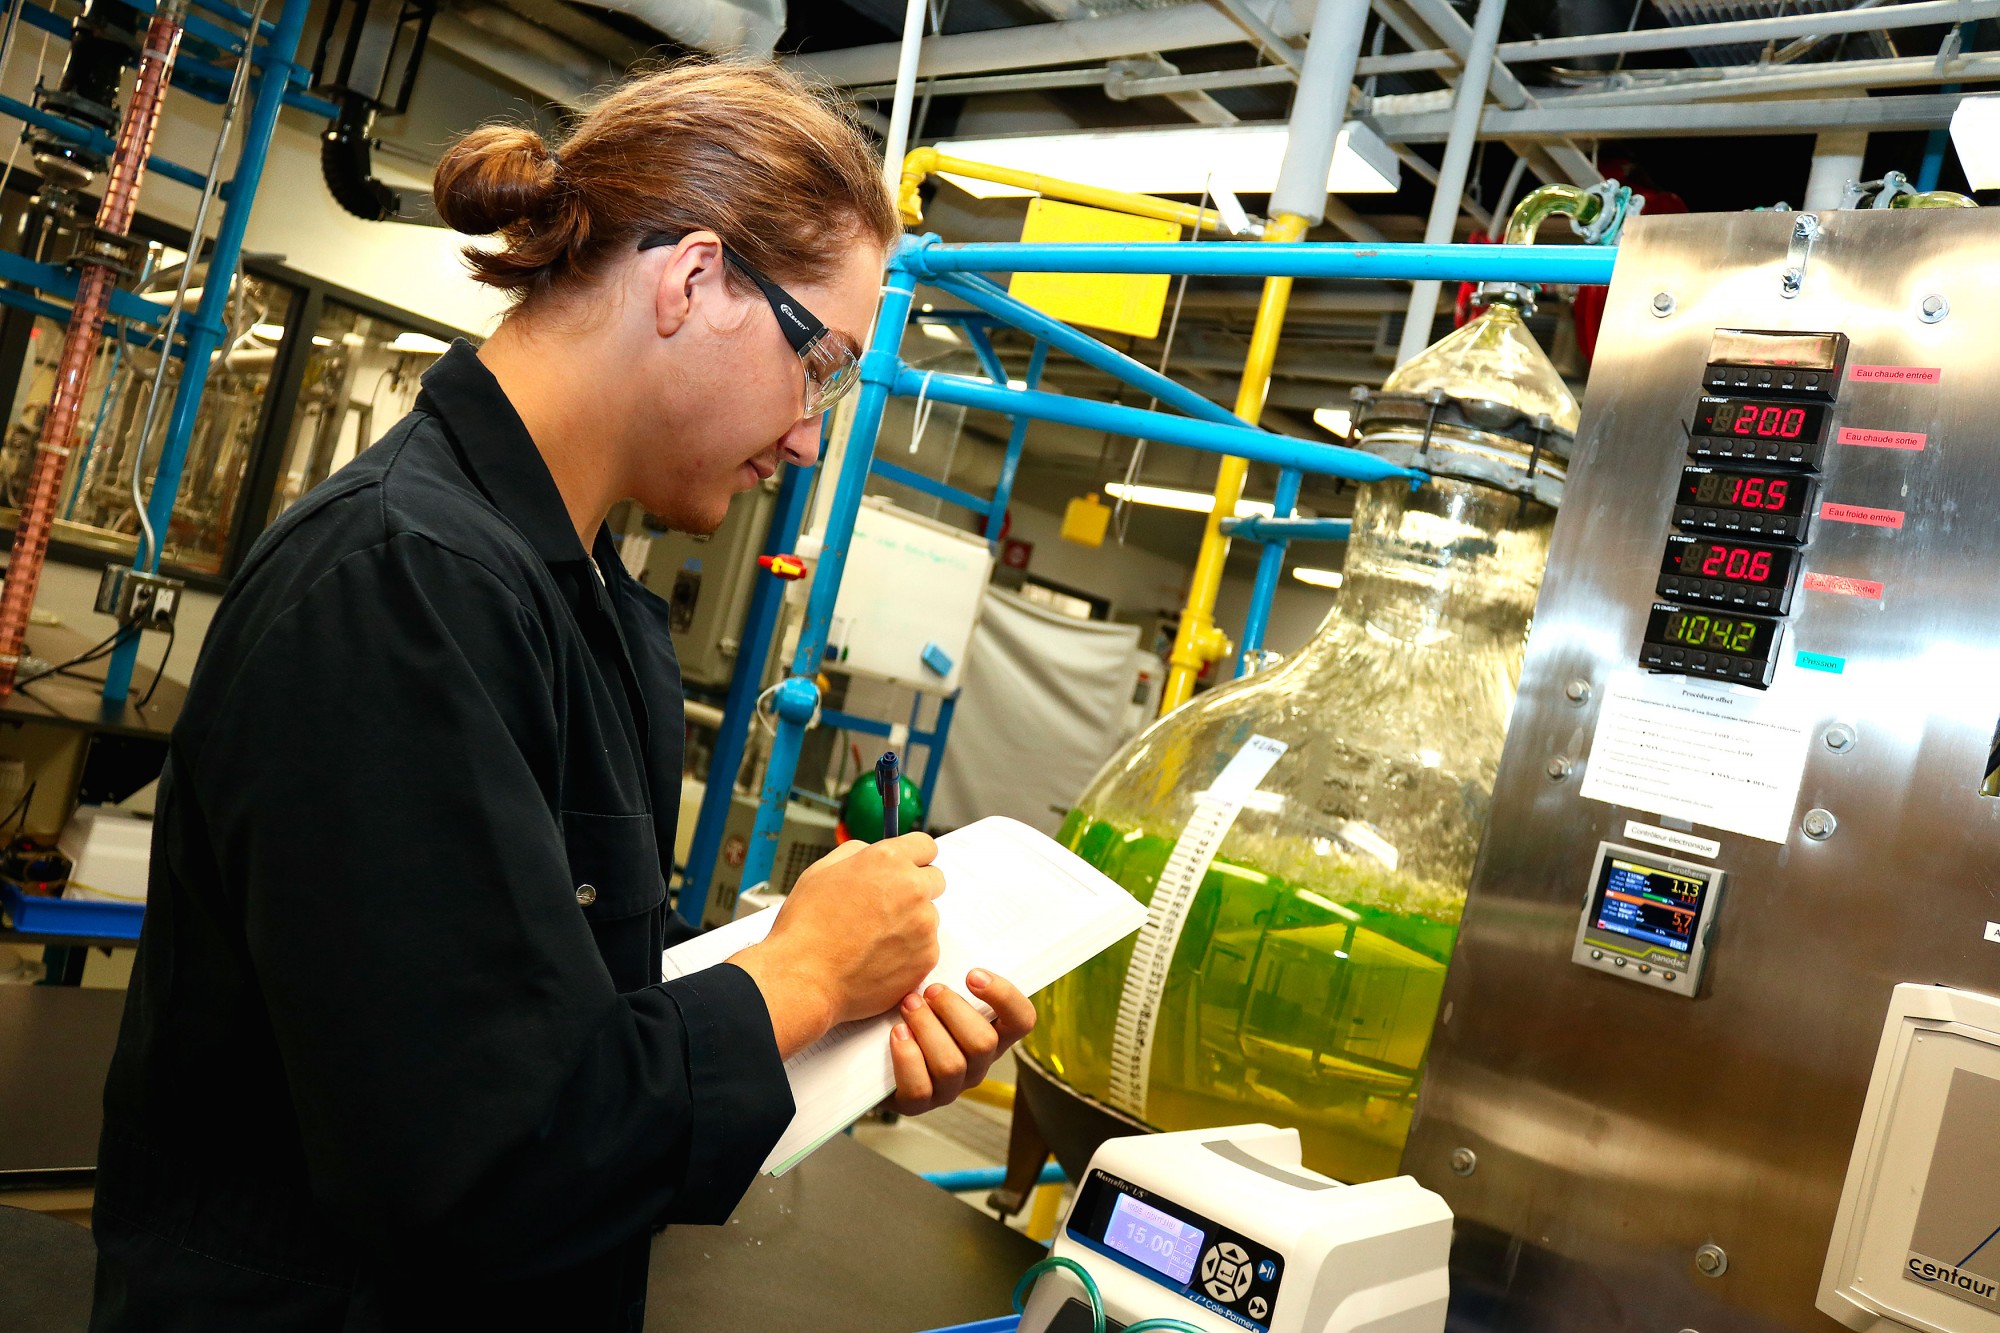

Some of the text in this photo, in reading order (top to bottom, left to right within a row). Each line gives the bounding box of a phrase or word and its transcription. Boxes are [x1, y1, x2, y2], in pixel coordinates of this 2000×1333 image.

[1856, 369, 1933, 380] Eau chaude entrée
[1733, 405, 1806, 438] 20.0
[1845, 432, 1918, 446] Eau chaude sortie
[1731, 477, 1788, 510] 16.5
[1828, 507, 1896, 523] Eau froide entrée
[1702, 545, 1772, 582] 20.6
[1677, 615, 1756, 652] 104.2
[1803, 656, 1838, 669] Pression
[1631, 826, 1713, 853] Contrôleur électronique
[1668, 863, 1708, 880] Eurotherm
[1671, 879, 1700, 898] 1.13
[1126, 1220, 1175, 1258] 15.00
[1908, 1258, 1996, 1299] centaur
[1205, 1300, 1255, 1330] Cole-Parmer
